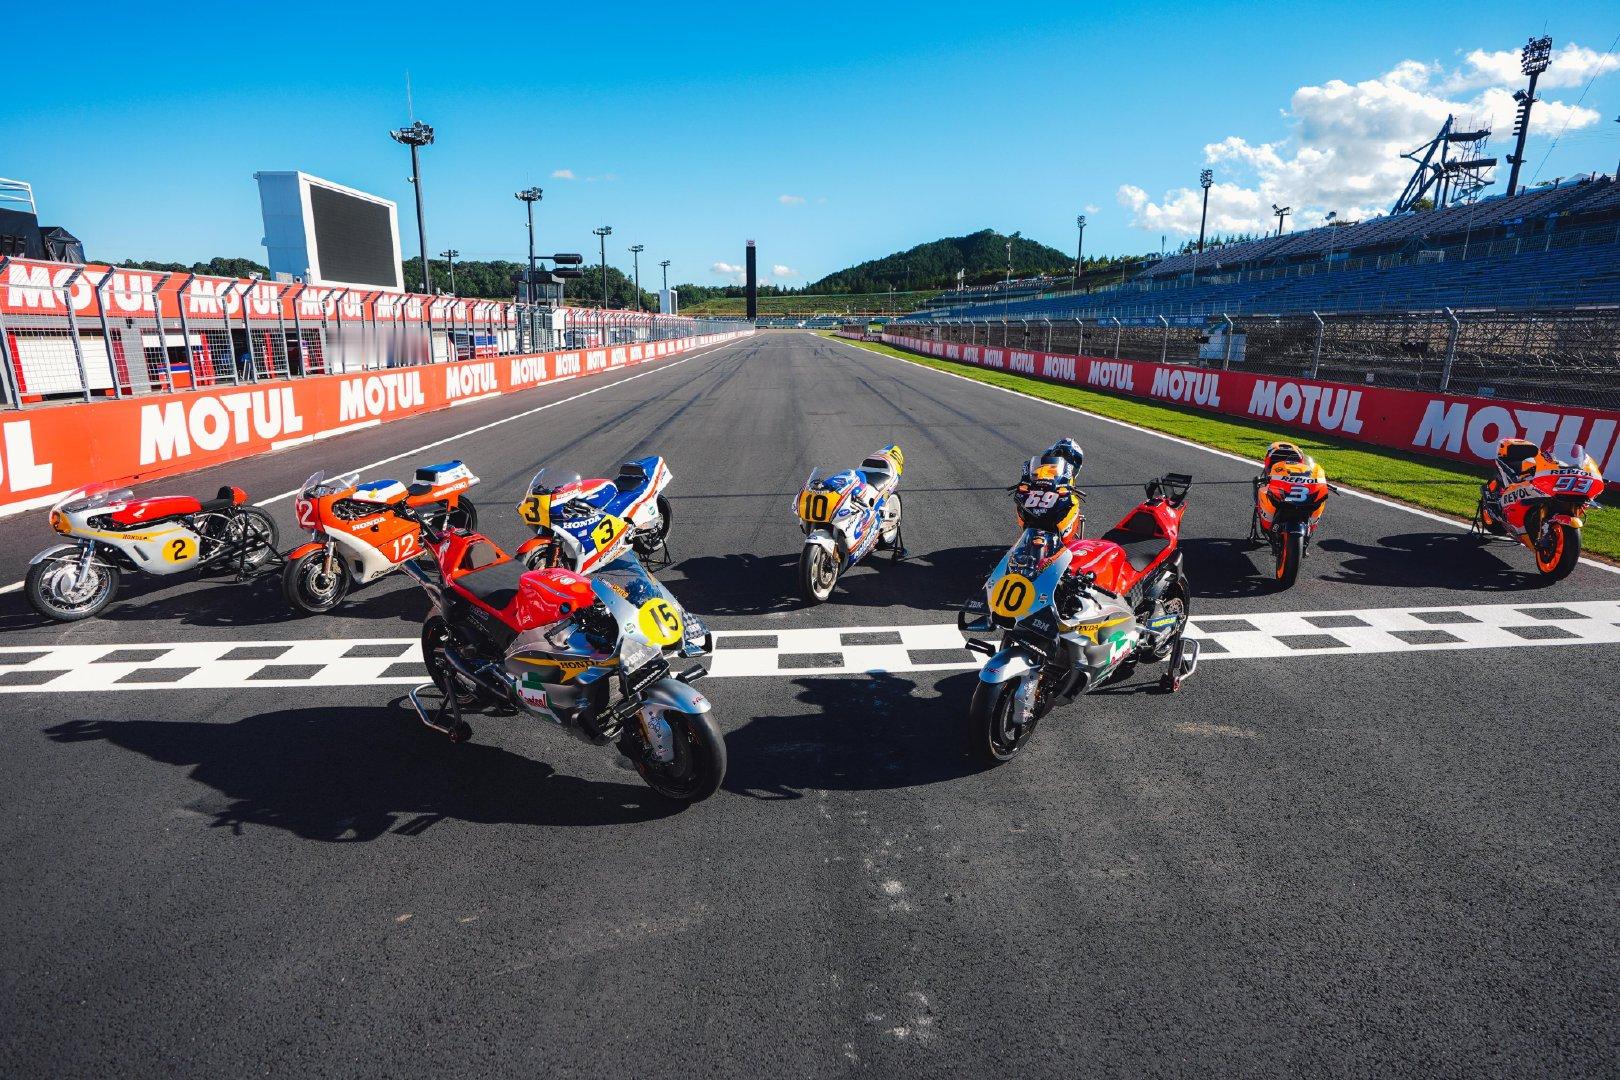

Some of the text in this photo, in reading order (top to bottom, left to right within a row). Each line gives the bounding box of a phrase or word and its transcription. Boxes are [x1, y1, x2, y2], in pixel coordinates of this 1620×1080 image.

[8, 264, 162, 311] MOTUL
[190, 280, 283, 315] MOTUL
[555, 353, 581, 377] MOTUL
[586, 352, 607, 371] MOTUL
[985, 349, 1004, 368] MOTUL
[1010, 352, 1036, 373] MOTUL
[1043, 355, 1076, 381] MOTUL
[446, 363, 498, 400] MOTUL
[511, 358, 546, 386] MOTUL
[1088, 361, 1134, 391] MOTUL
[340, 372, 424, 422] MOTUL
[1152, 368, 1221, 407] MOTUL
[1248, 380, 1363, 434] MOTUL
[139, 387, 303, 466] MOTUL
[0, 419, 53, 492] L
[1280, 475, 1318, 483] REPSOL
[1550, 469, 1592, 477] REPSOL
[1552, 477, 1594, 493] 93
[1024, 490, 1060, 509] 69
[1284, 486, 1309, 502] 3
[525, 498, 541, 522] 3
[805, 494, 828, 521] 10
[352, 516, 386, 532] HONDA
[563, 514, 602, 530] HONDA
[599, 519, 614, 544] 3
[171, 540, 188, 561] 2
[392, 532, 416, 561] 12
[995, 579, 1026, 612] 10
[649, 603, 679, 638] 15
[1031, 618, 1051, 632] IBM
